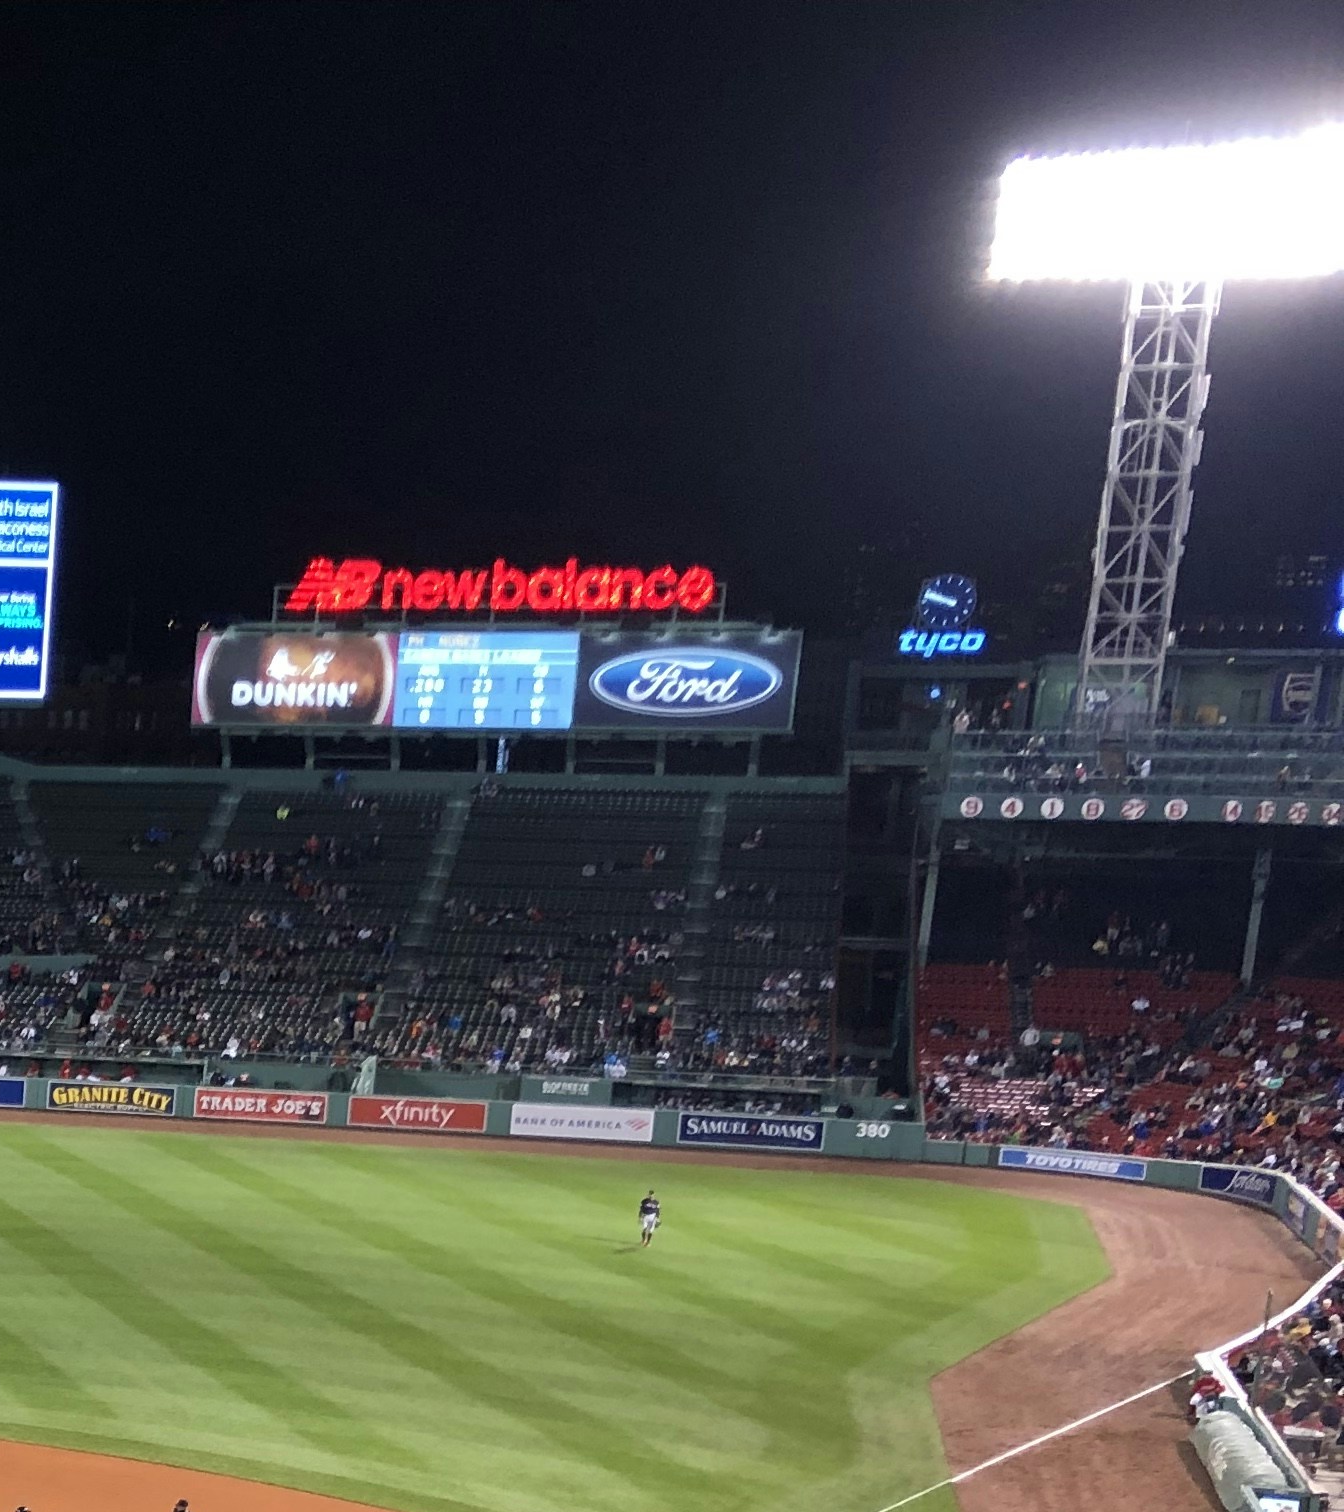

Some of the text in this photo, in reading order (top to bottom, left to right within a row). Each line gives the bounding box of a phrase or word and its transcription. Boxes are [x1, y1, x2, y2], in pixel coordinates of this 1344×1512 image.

[381, 567, 489, 610] new
[491, 556, 716, 613] balance
[898, 626, 987, 658] tyco
[231, 681, 357, 707] DUNKIN'
[626, 659, 743, 705] Ford
[52, 1086, 172, 1112] GRANITE CITY
[200, 1095, 322, 1116] TRADER JOE'S
[380, 1100, 455, 1129] xfinity
[514, 1116, 547, 1127] BANK
[567, 1118, 623, 1130] AMERICA
[686, 1116, 816, 1142] SAMUEL ADAMS
[856, 1123, 891, 1139] 380
[1026, 1153, 1119, 1174] TOYO TIRES
